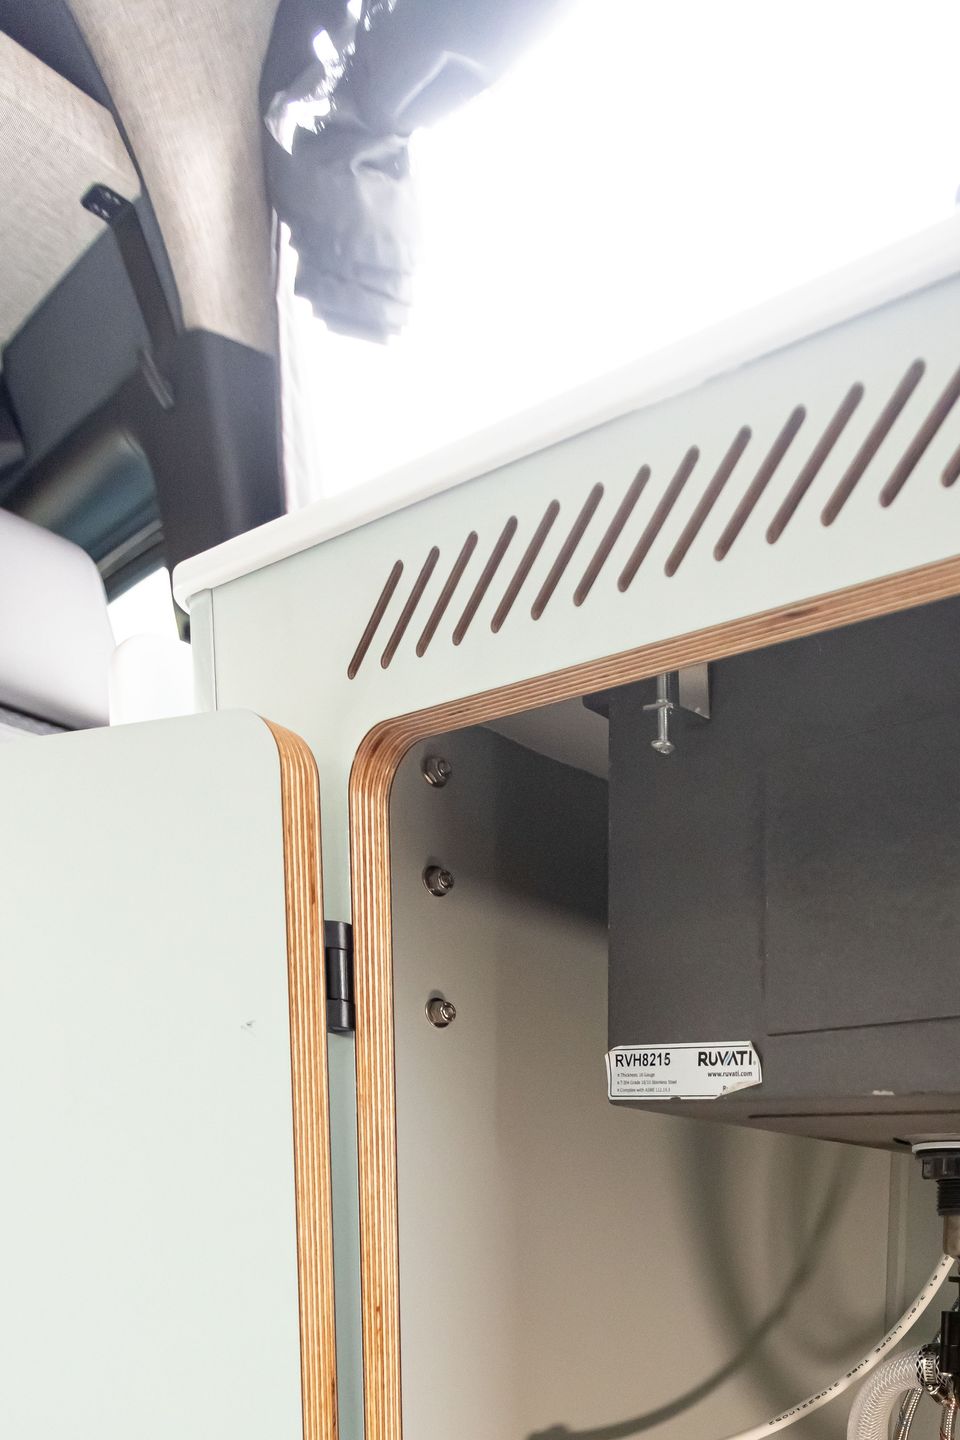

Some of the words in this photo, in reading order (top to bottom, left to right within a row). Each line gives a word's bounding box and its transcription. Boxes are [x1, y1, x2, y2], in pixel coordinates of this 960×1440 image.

[615, 1052, 671, 1067] RVH8215
[698, 1050, 752, 1067] RUVATI
[707, 1070, 753, 1078] www.ruvati.com
[875, 1325, 902, 1354] LLDPE
[846, 1359, 870, 1378] TUBE
